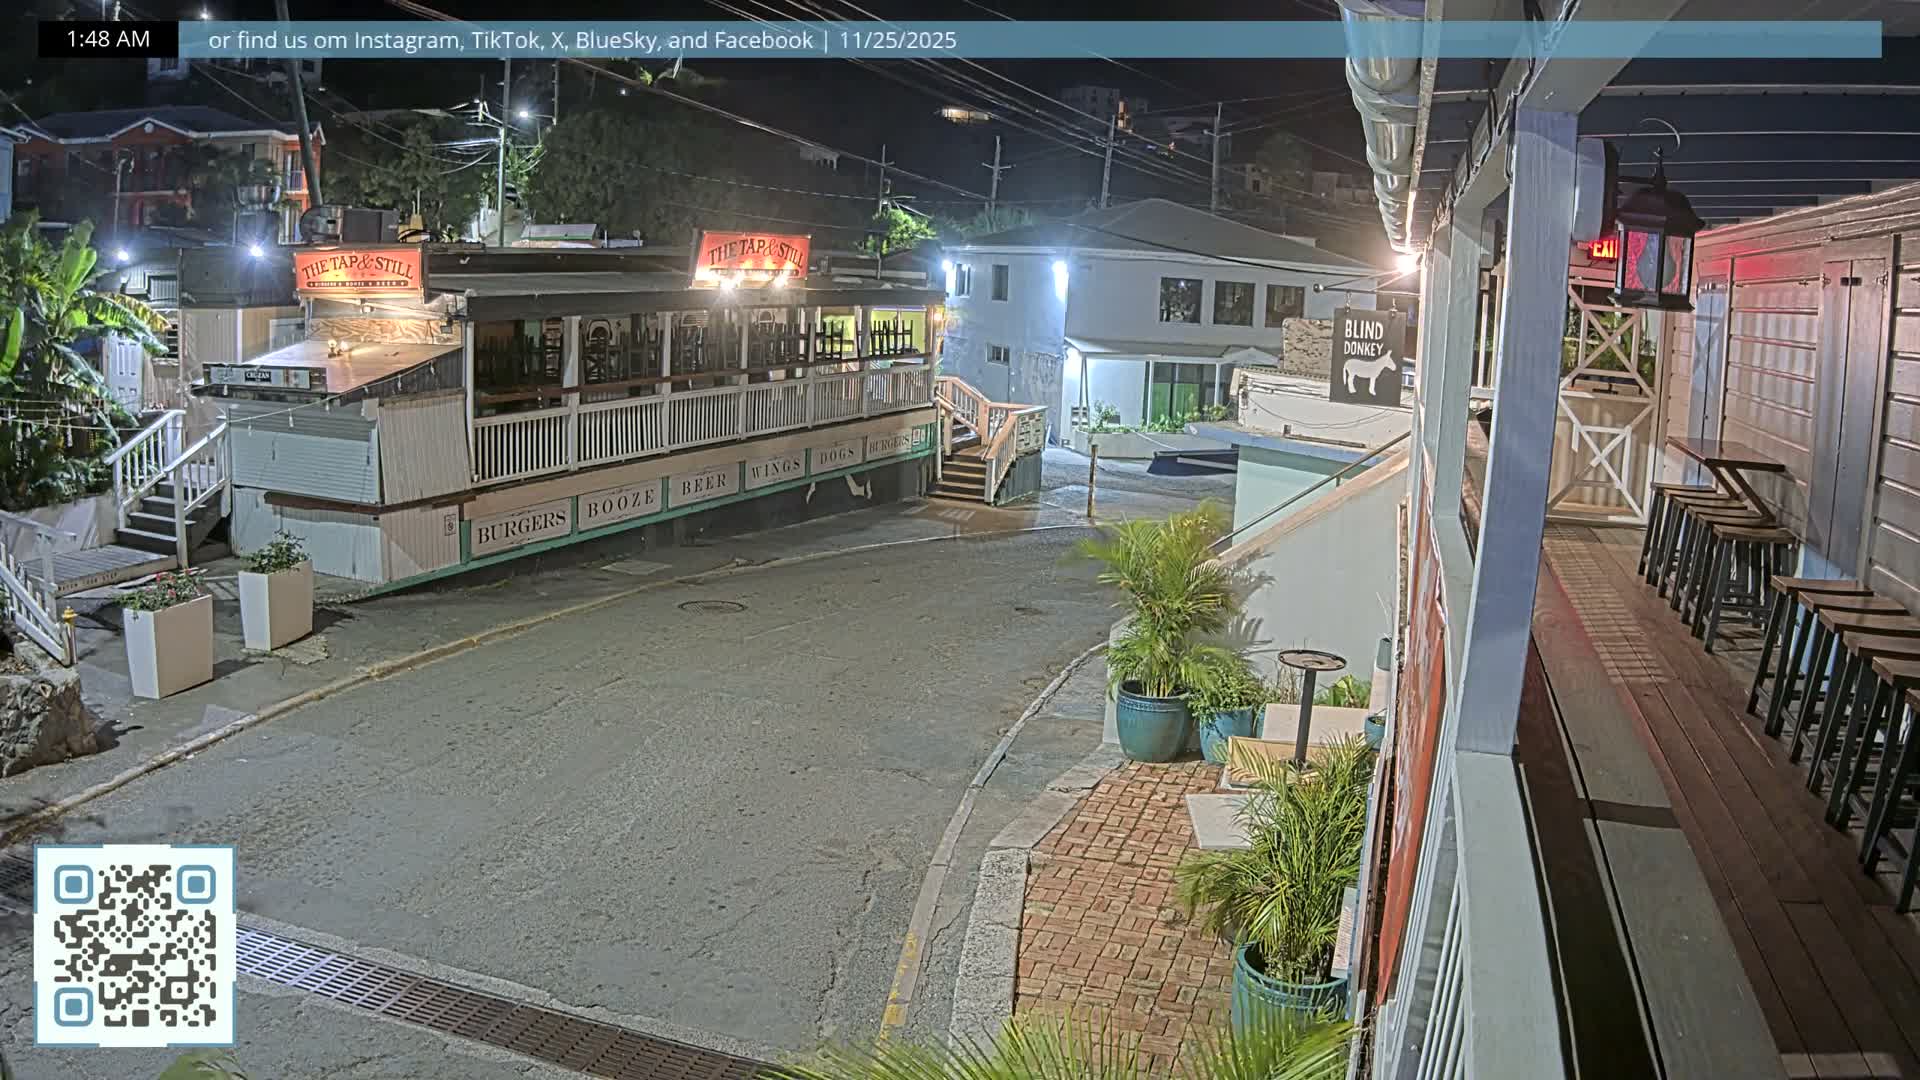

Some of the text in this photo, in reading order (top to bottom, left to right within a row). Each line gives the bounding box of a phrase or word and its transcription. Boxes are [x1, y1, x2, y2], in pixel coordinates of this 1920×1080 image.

[709, 238, 803, 269] THE TAP & STILL
[1593, 240, 1618, 258] EXI
[302, 253, 414, 280] THE TAP & STILL
[1345, 319, 1384, 340] BLIND
[1343, 341, 1384, 356] DONKEY
[869, 433, 911, 454] BURGERS
[819, 446, 855, 465] DOGS
[752, 459, 801, 479] WINGS
[682, 472, 728, 496] BEER
[588, 489, 654, 518] BOOZE
[478, 510, 567, 545] BURGERS
